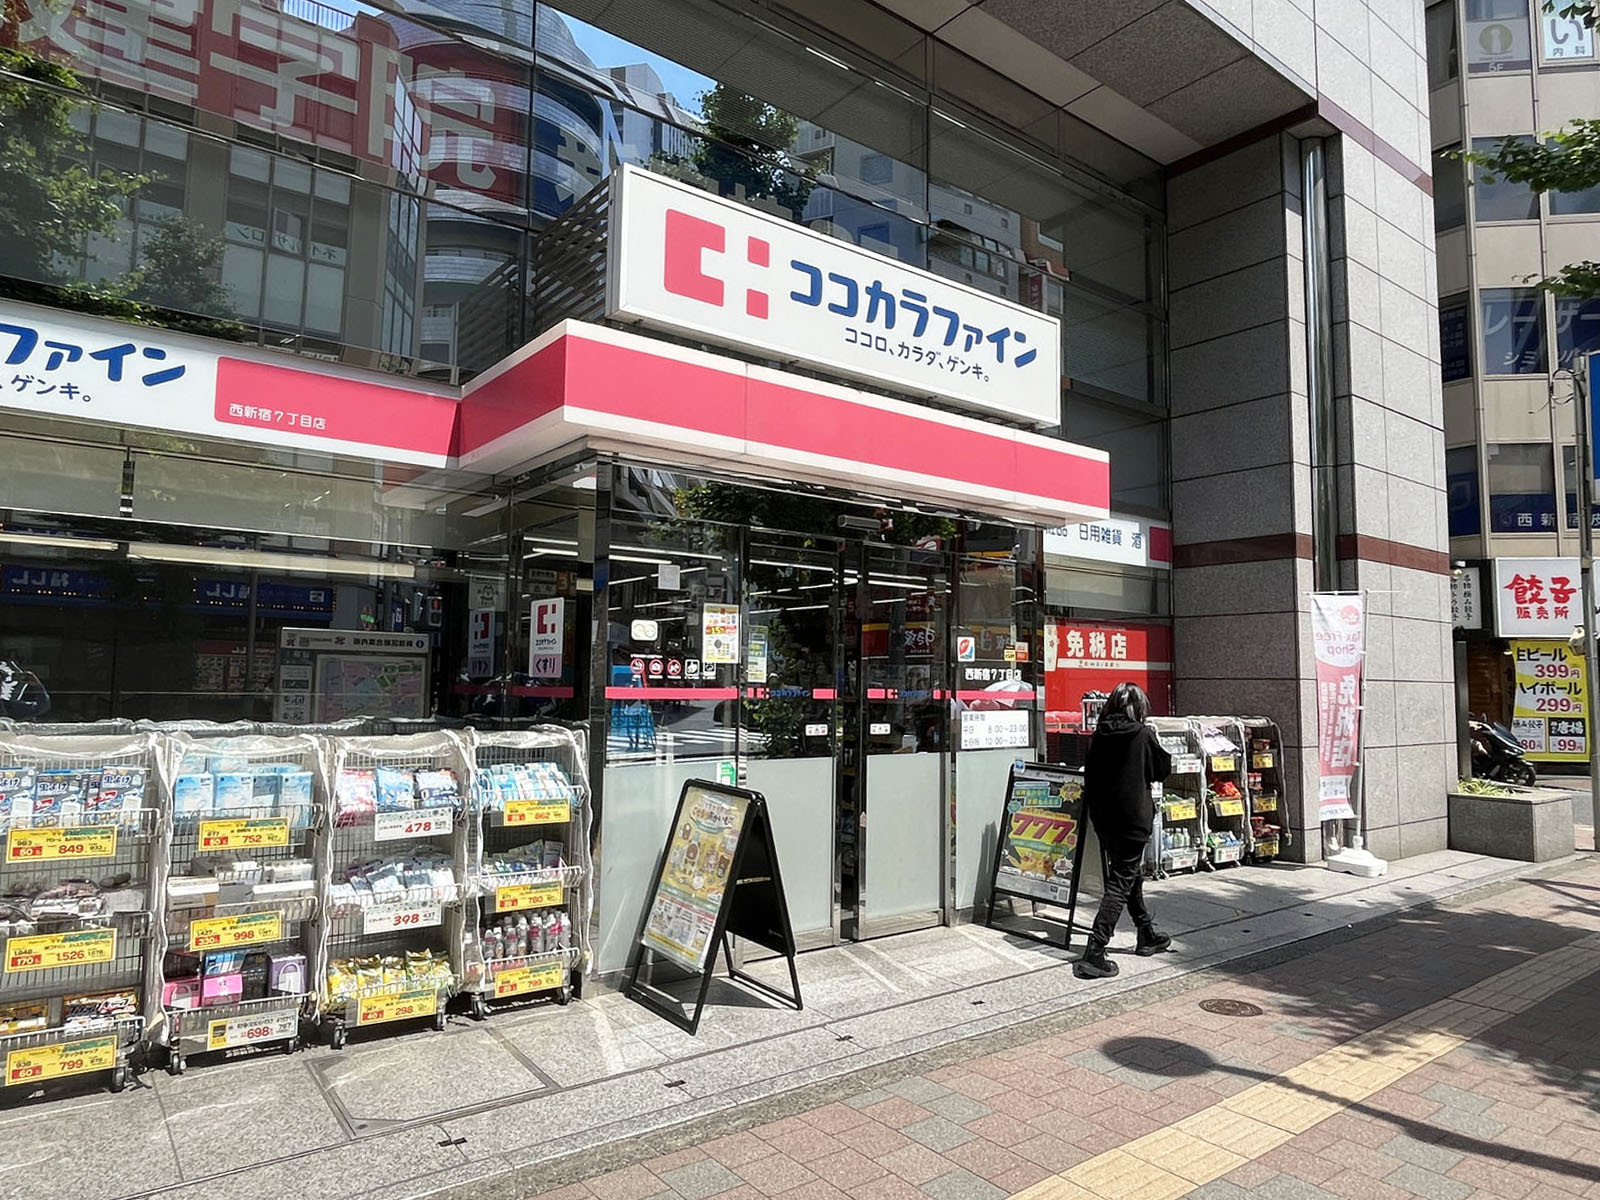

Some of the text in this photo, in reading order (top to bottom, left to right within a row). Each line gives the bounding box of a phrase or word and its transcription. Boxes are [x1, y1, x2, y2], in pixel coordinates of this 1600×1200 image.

[790, 258, 1037, 368] ココカラファイン
[229, 402, 327, 430] 西新宿7丁目店
[1079, 523, 1122, 546] 日用雑貨
[1503, 573, 1577, 605] 餃子
[1515, 605, 1569, 620] 販売所
[1066, 629, 1127, 660] 免税店
[965, 667, 1022, 681] 西新宿7丁目店
[58, 844, 84, 854] 849
[393, 913, 420, 926] 398
[233, 930, 255, 941] 998
[247, 1026, 270, 1039] 698
[59, 1058, 84, 1071] 799
